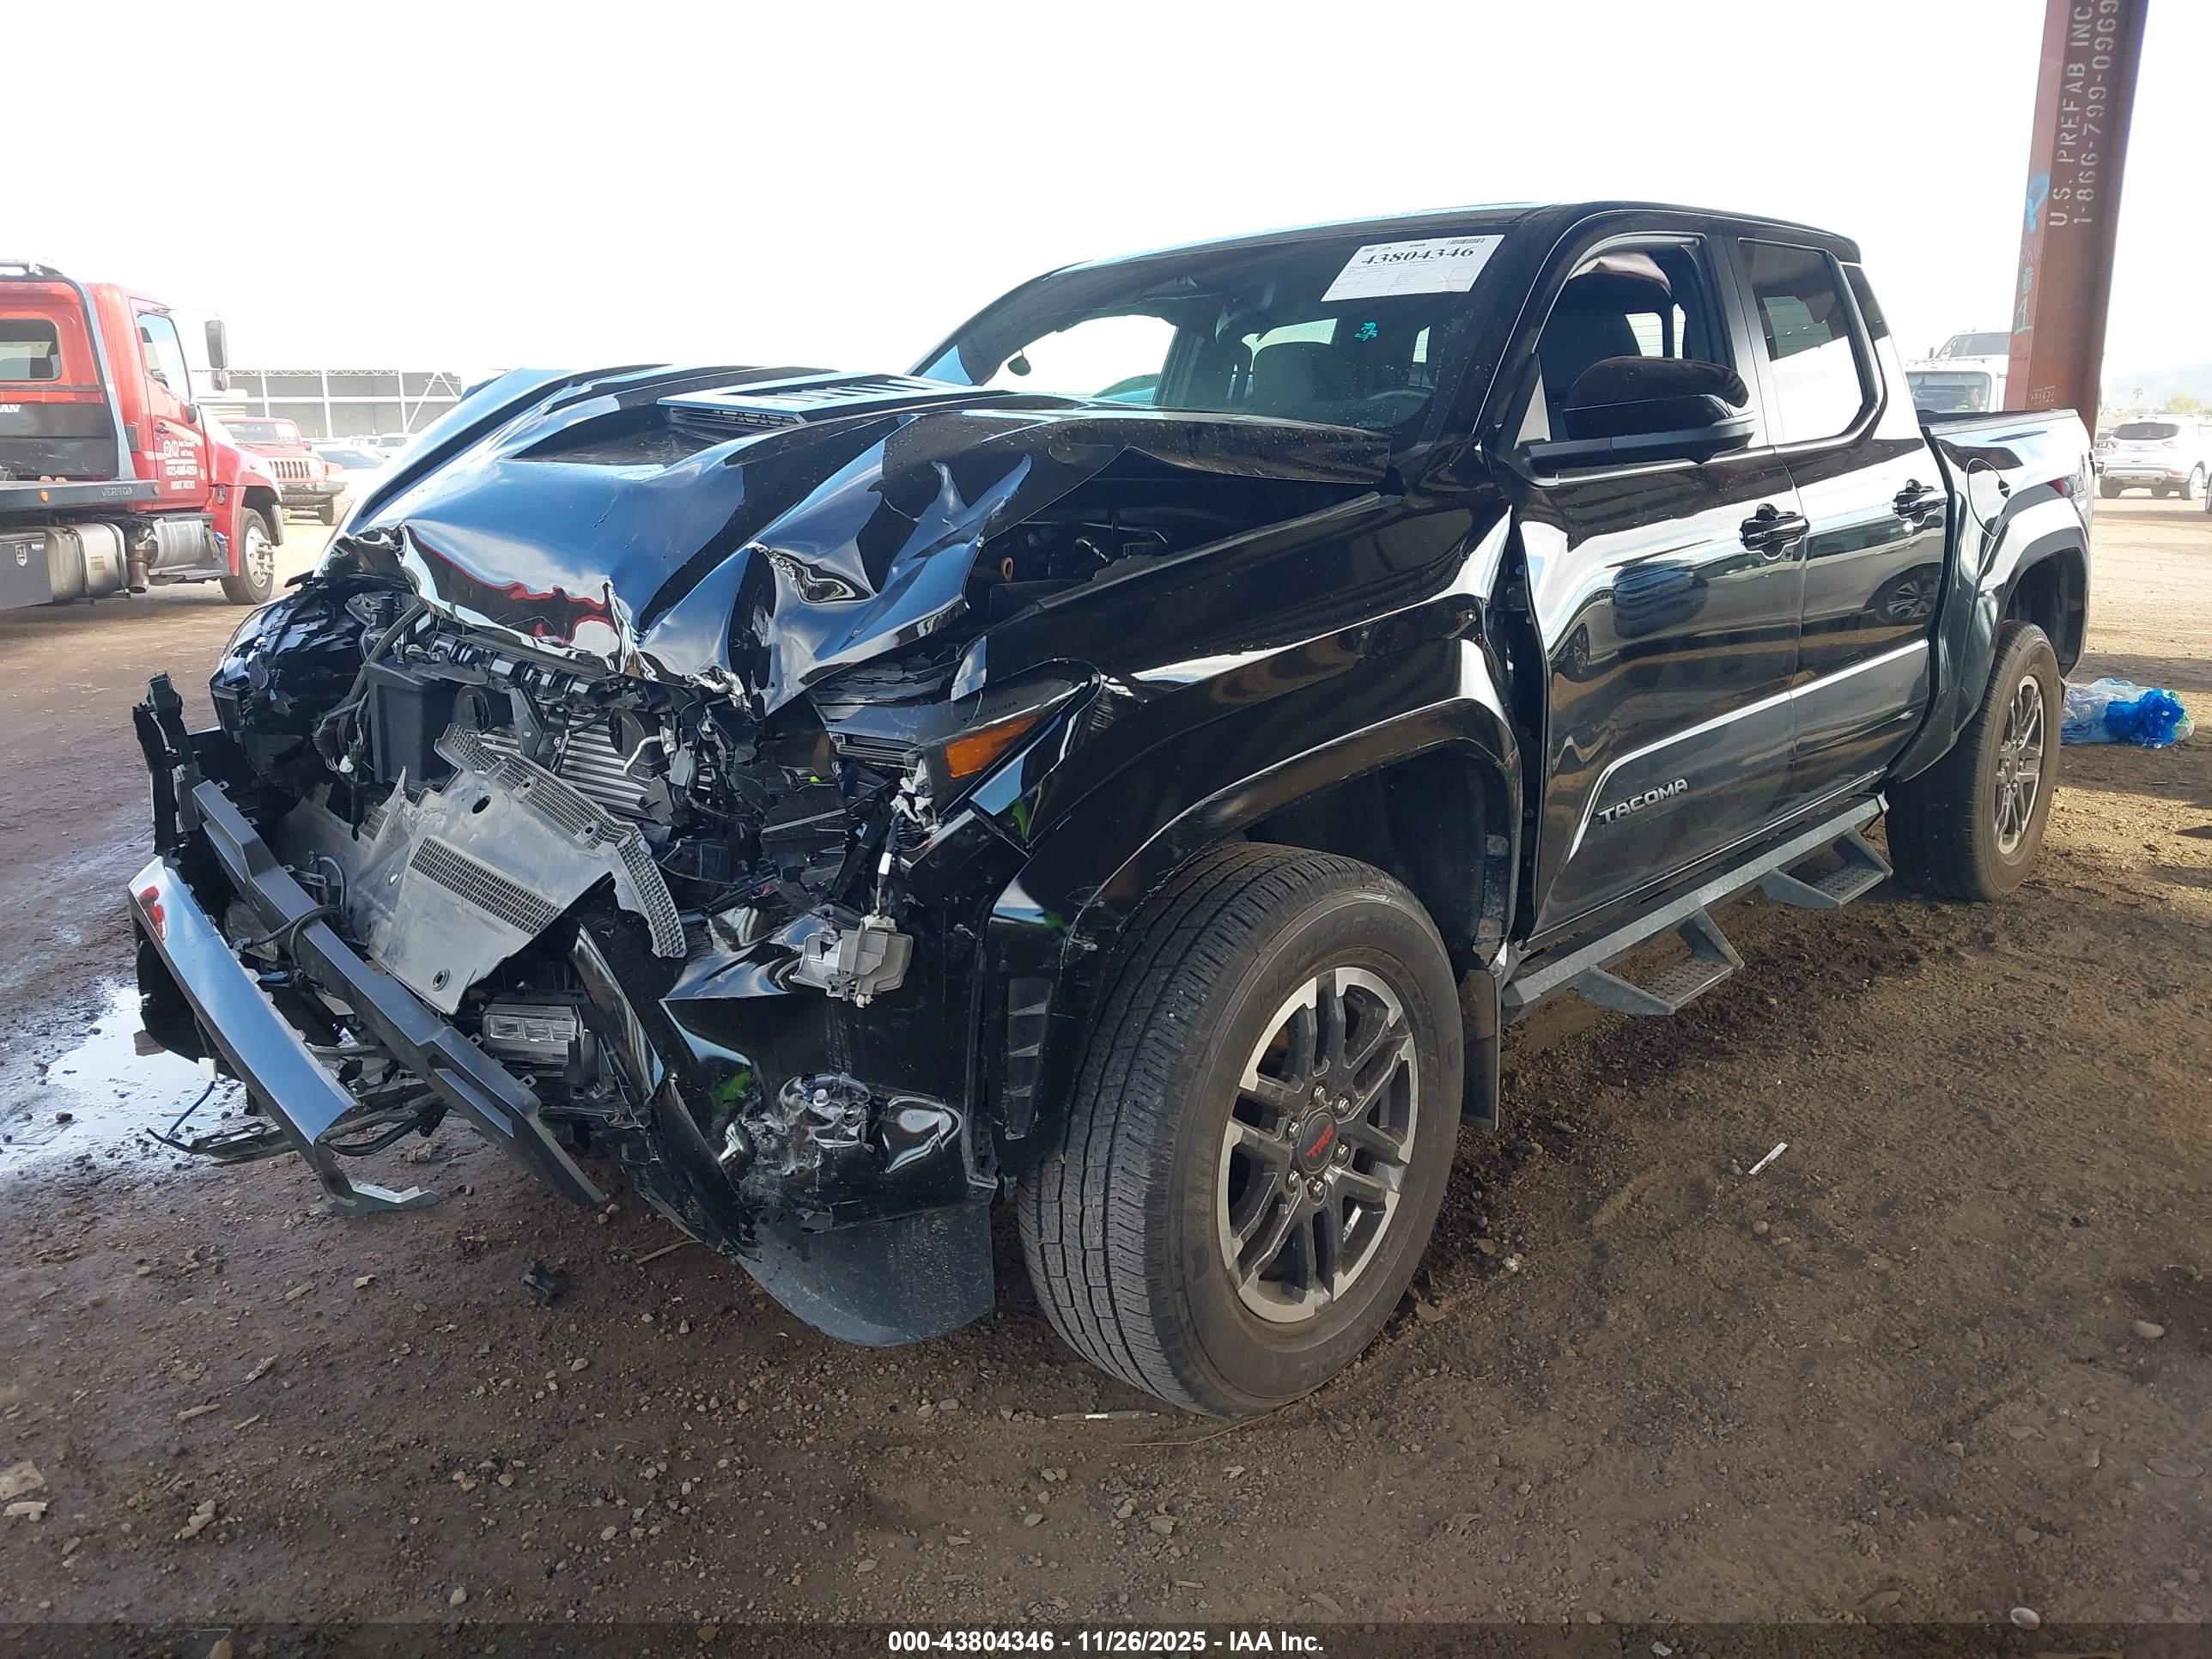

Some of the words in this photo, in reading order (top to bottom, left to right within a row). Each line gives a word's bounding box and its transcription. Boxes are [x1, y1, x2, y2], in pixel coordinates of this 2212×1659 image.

[2057, 63, 2085, 162] PREFAB
[2050, 179, 2072, 226] U.S.
[1361, 246, 1477, 264] 43804346
[1597, 778, 1688, 823] TACOMA
[1306, 1124, 1334, 1158] TRD
